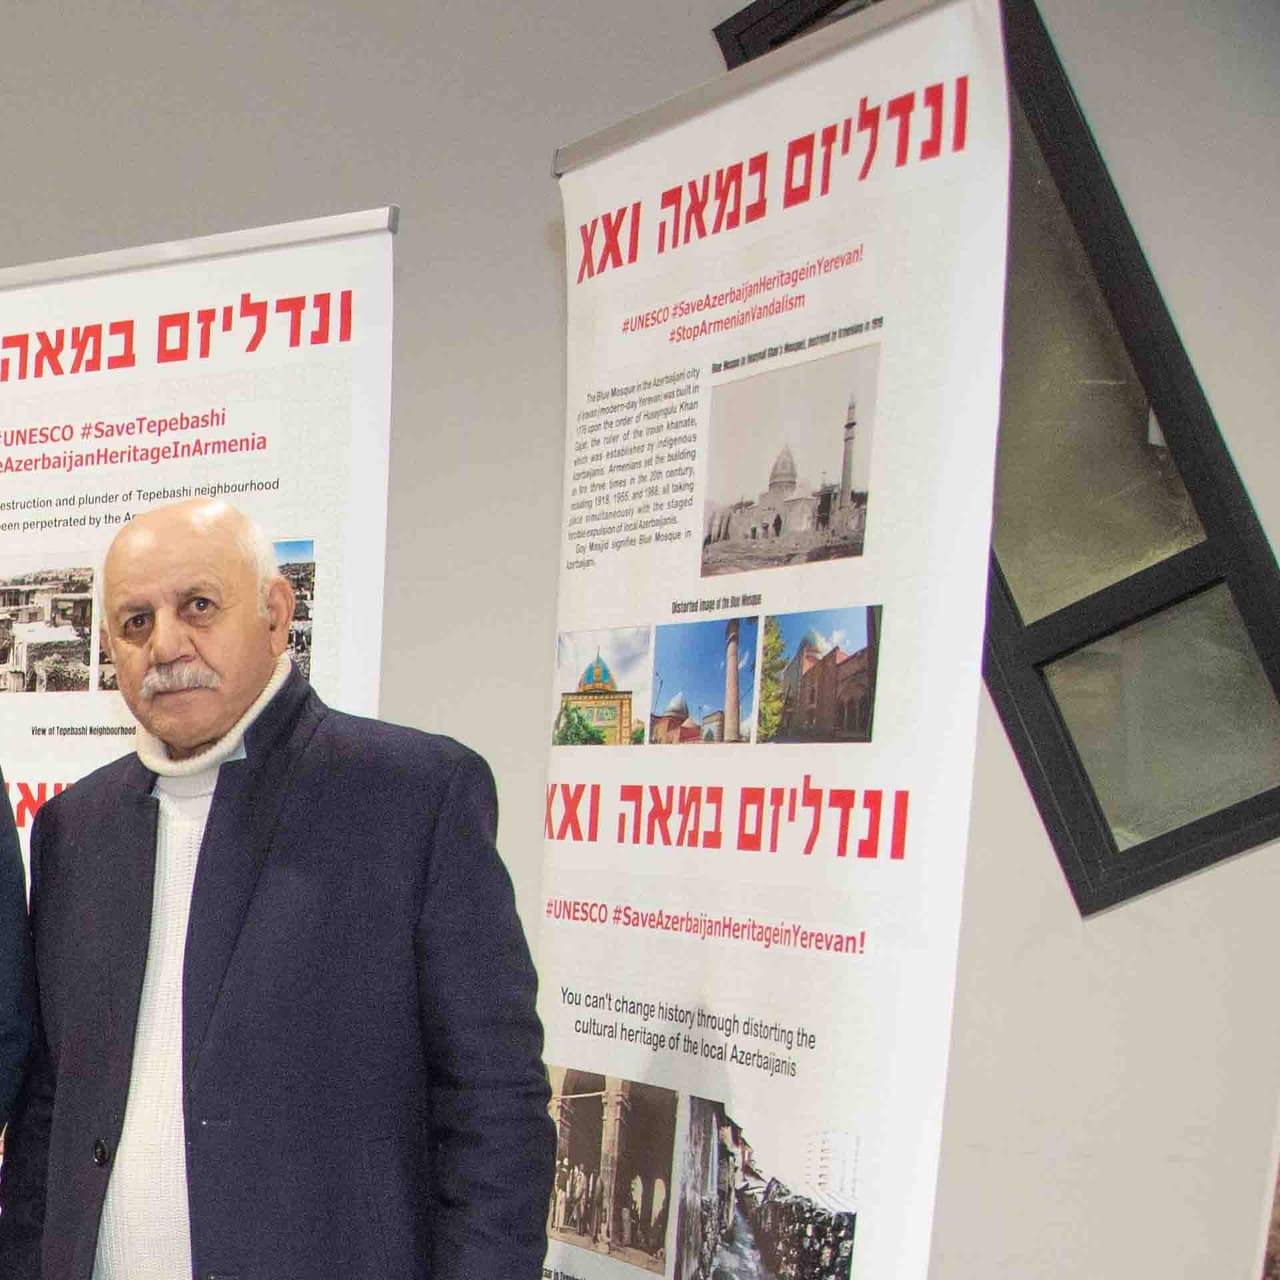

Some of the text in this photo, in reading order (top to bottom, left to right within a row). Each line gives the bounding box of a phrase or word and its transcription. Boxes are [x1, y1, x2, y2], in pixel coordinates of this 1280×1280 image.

[577, 74, 969, 284] ונדליזם במאה XXI
[622, 243, 864, 334] #UNESCO #SaveAzerbaijanHeritageinYerevan!
[669, 292, 805, 344] #StopArmenianVandalism
[0, 318, 136, 383] במאה
[156, 289, 353, 364] ונדליזם
[80, 407, 227, 441] #SaveTepebashi
[22, 514, 86, 536] perpetrated
[88, 514, 103, 531] by
[104, 512, 122, 528] the
[55, 492, 75, 508] and
[77, 488, 119, 509] plunder
[121, 488, 133, 503] of
[135, 483, 192, 505] Tepebashi
[193, 478, 280, 503] neighbourhood
[31, 725, 46, 735] View
[616, 784, 724, 850] במאה
[736, 774, 910, 861] ונדליזם
[546, 898, 866, 955] #UNESCO #SaveAzerbaijanHeritageinYerevan!
[560, 986, 581, 1007] You
[614, 994, 656, 1021] change
[657, 1002, 696, 1029] history
[696, 1008, 740, 1037] through
[742, 1015, 794, 1050] distorting
[796, 1026, 817, 1050] the
[574, 1017, 797, 1078] cultural heritage of the local Azerbaijanis
